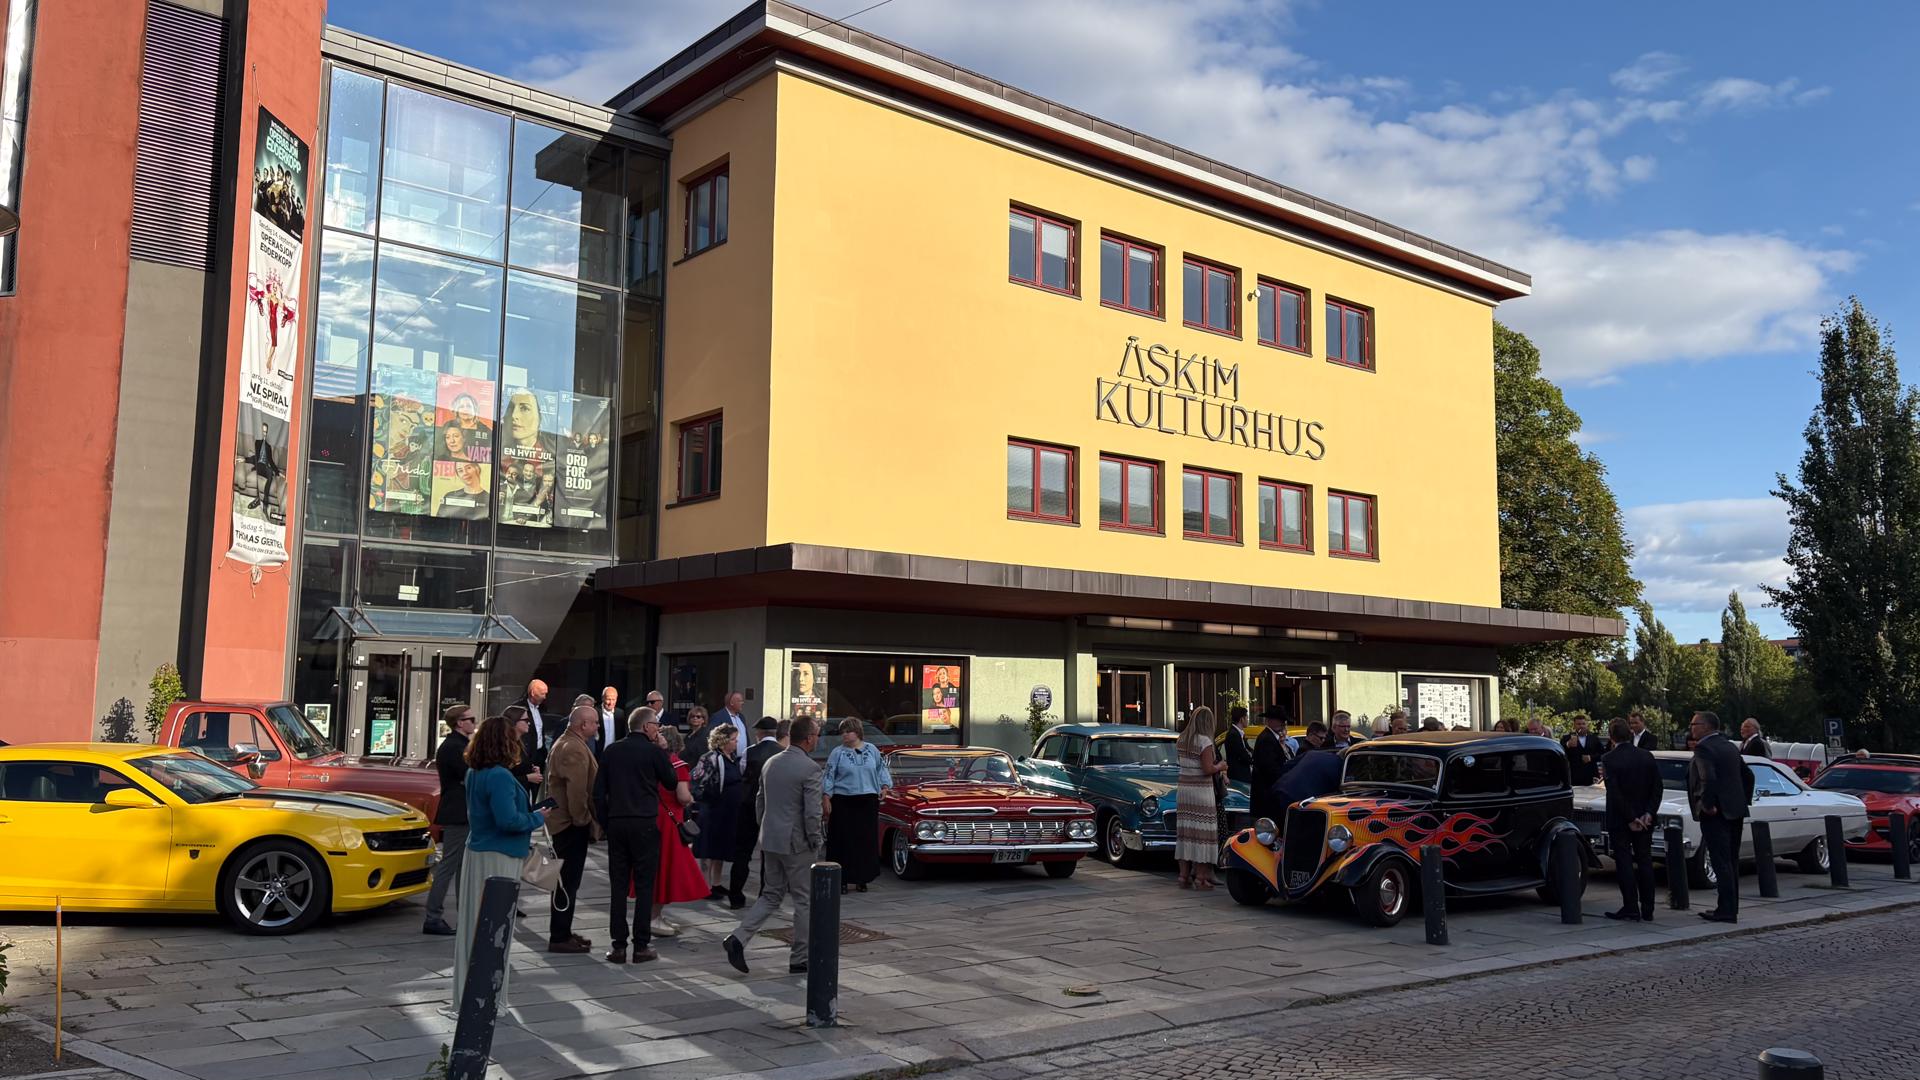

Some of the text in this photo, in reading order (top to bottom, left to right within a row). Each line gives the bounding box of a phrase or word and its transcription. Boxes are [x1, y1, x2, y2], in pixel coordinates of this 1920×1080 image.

[259, 242, 292, 269] EDDERKOPP
[260, 231, 294, 259] OPERASJON
[1117, 335, 1239, 403] ÅSKIM
[261, 387, 289, 408] SPIRAL
[1096, 376, 1326, 460] KULTURHUS
[467, 440, 492, 463] VÅRT
[503, 447, 516, 456] EN
[517, 449, 537, 459] HVIT
[537, 452, 554, 461] JUL
[566, 453, 588, 468] ORD
[381, 456, 430, 477] Frida
[565, 466, 586, 479] FOR
[565, 476, 592, 491] BLOD
[1829, 720, 1839, 735] P
